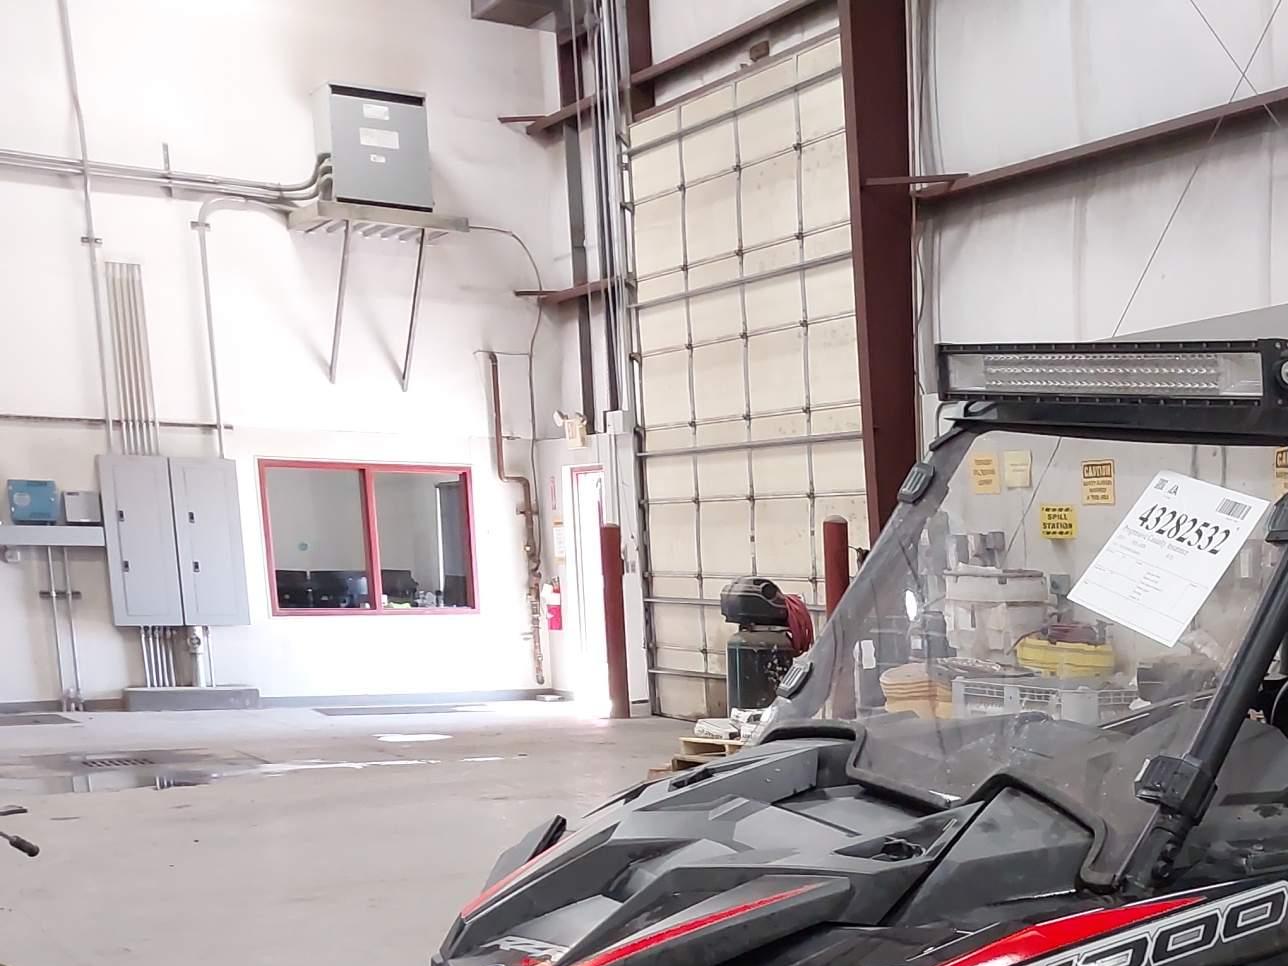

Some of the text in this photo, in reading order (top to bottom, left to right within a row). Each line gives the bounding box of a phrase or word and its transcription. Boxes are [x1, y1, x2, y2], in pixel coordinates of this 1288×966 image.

[1047, 513, 1068, 521] SPILL
[1042, 522, 1073, 530] STATION
[1138, 504, 1231, 555] 43282532
